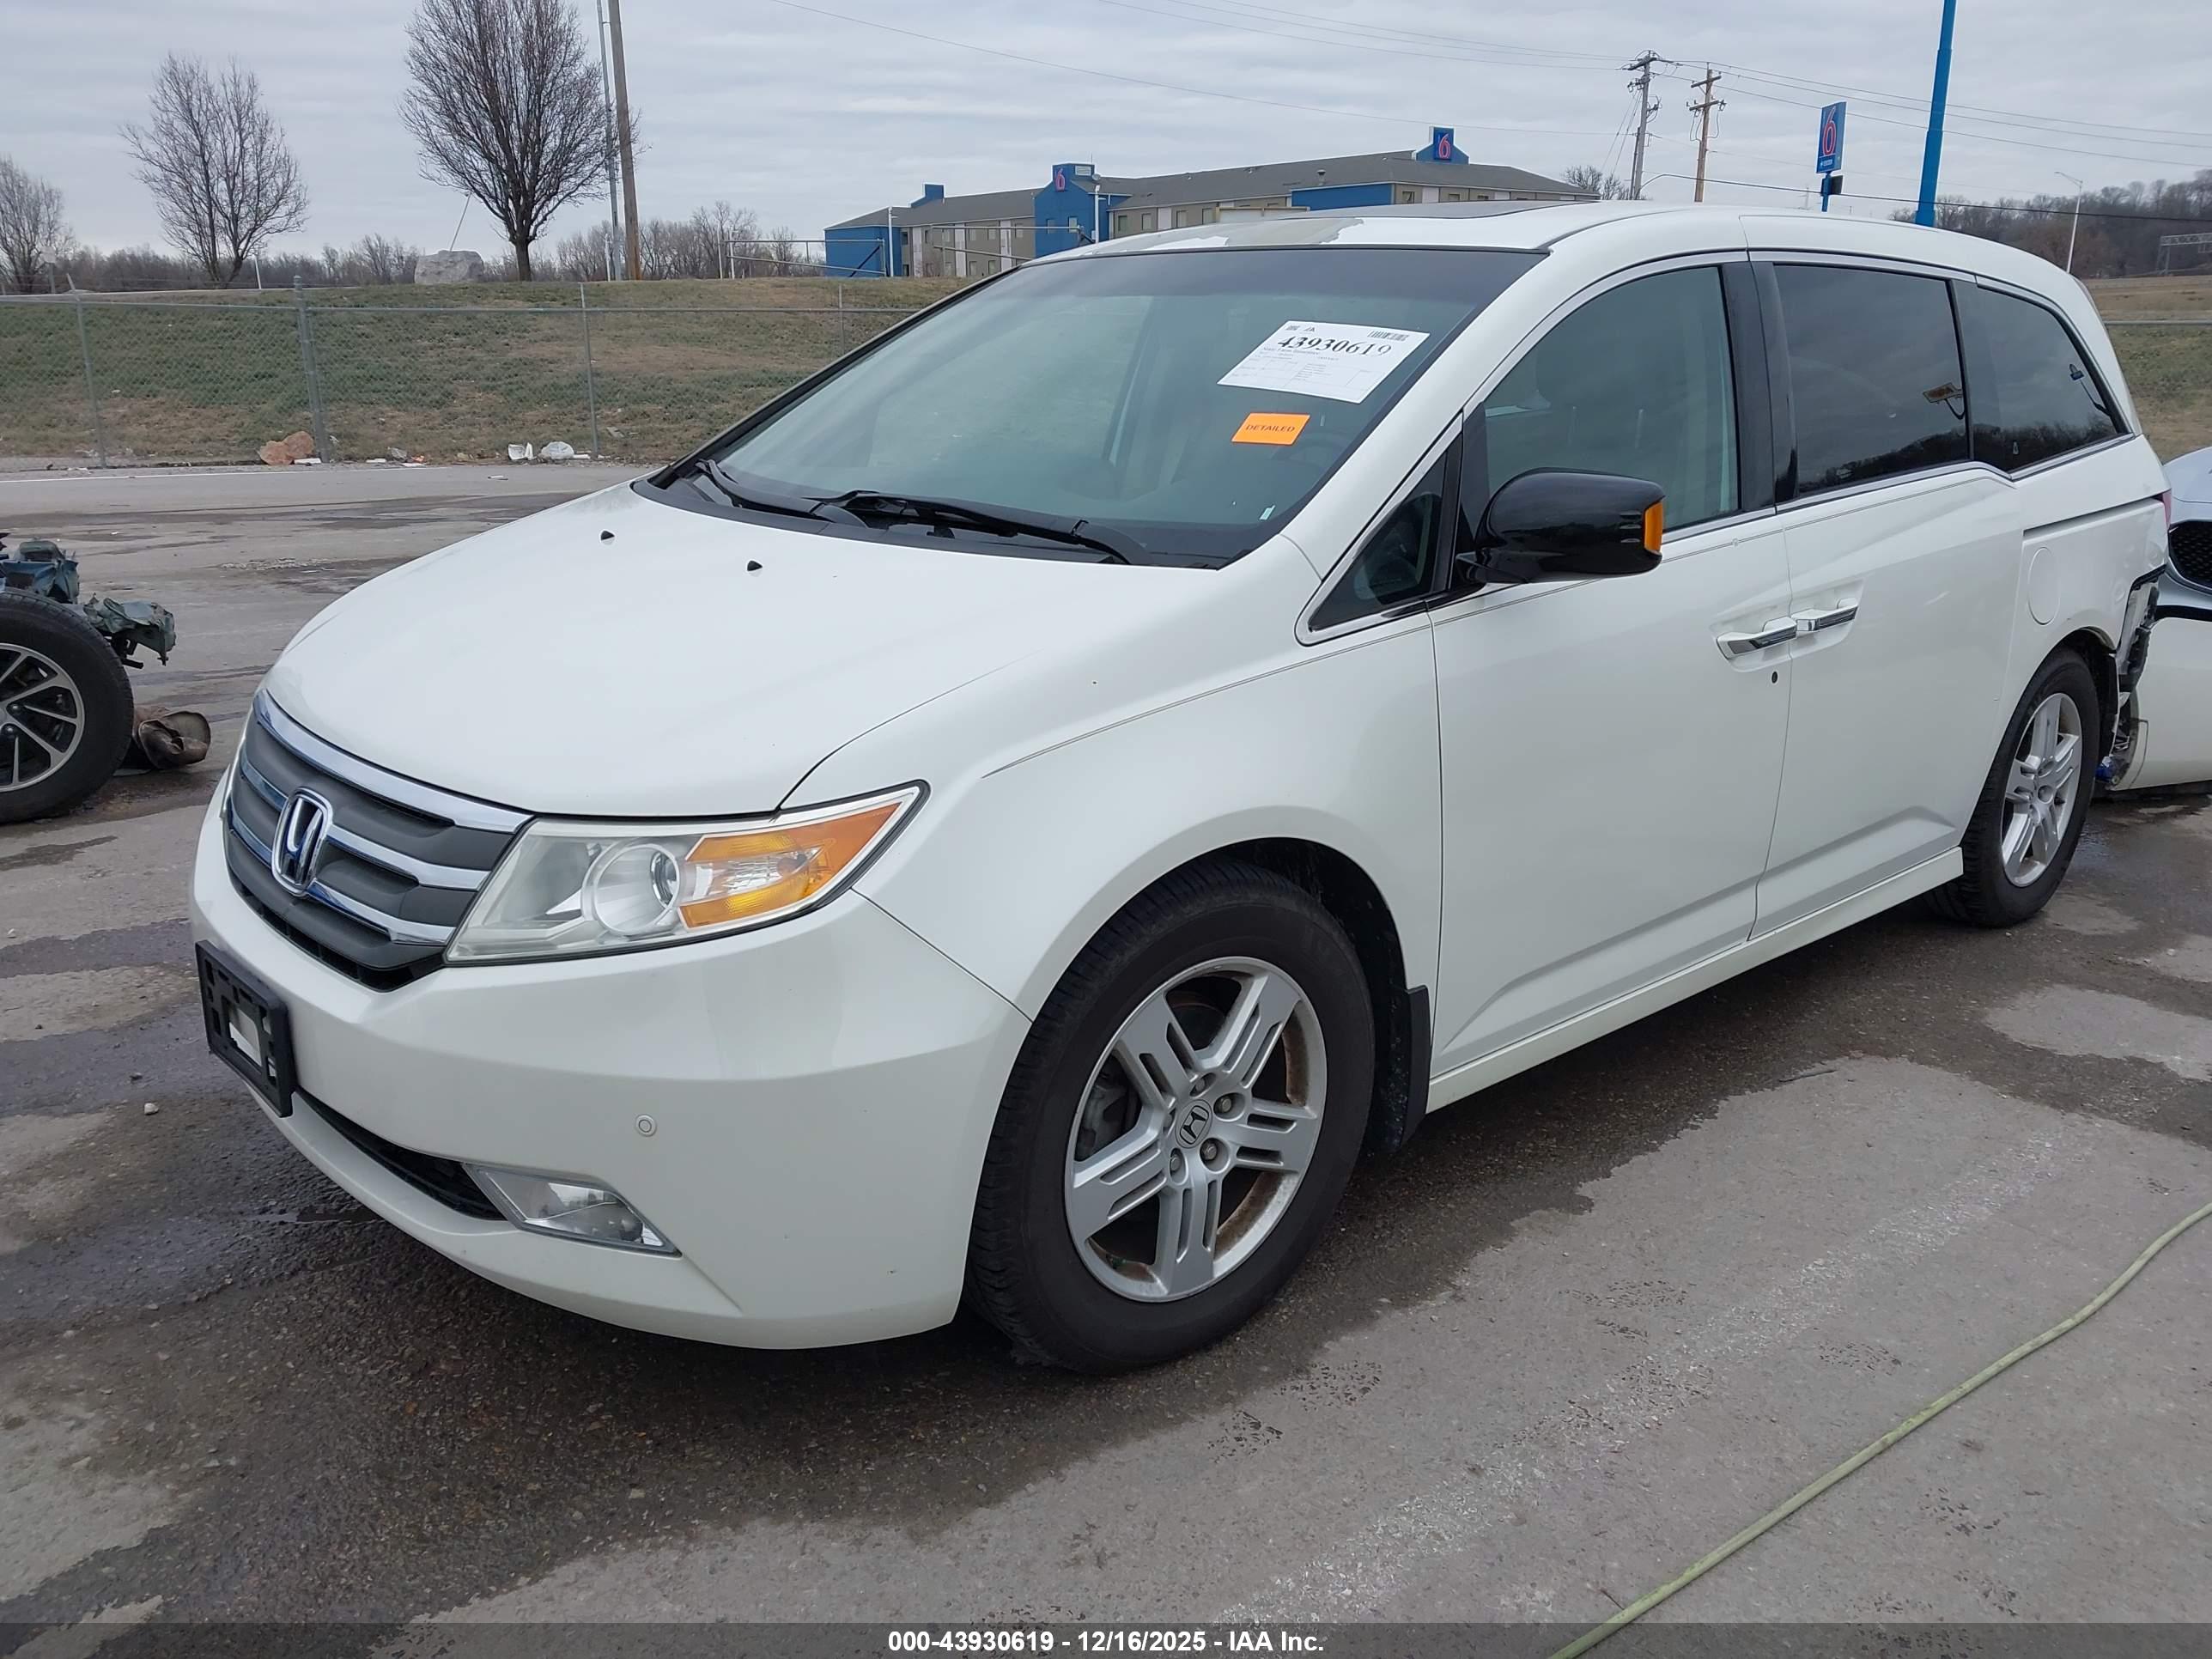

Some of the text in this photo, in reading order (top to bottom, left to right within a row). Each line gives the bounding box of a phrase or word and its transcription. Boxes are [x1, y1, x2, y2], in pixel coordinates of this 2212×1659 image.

[1822, 105, 1837, 156] 6
[1438, 133, 1451, 159] 6
[1055, 168, 1066, 191] 6
[1278, 336, 1392, 356] 43930619
